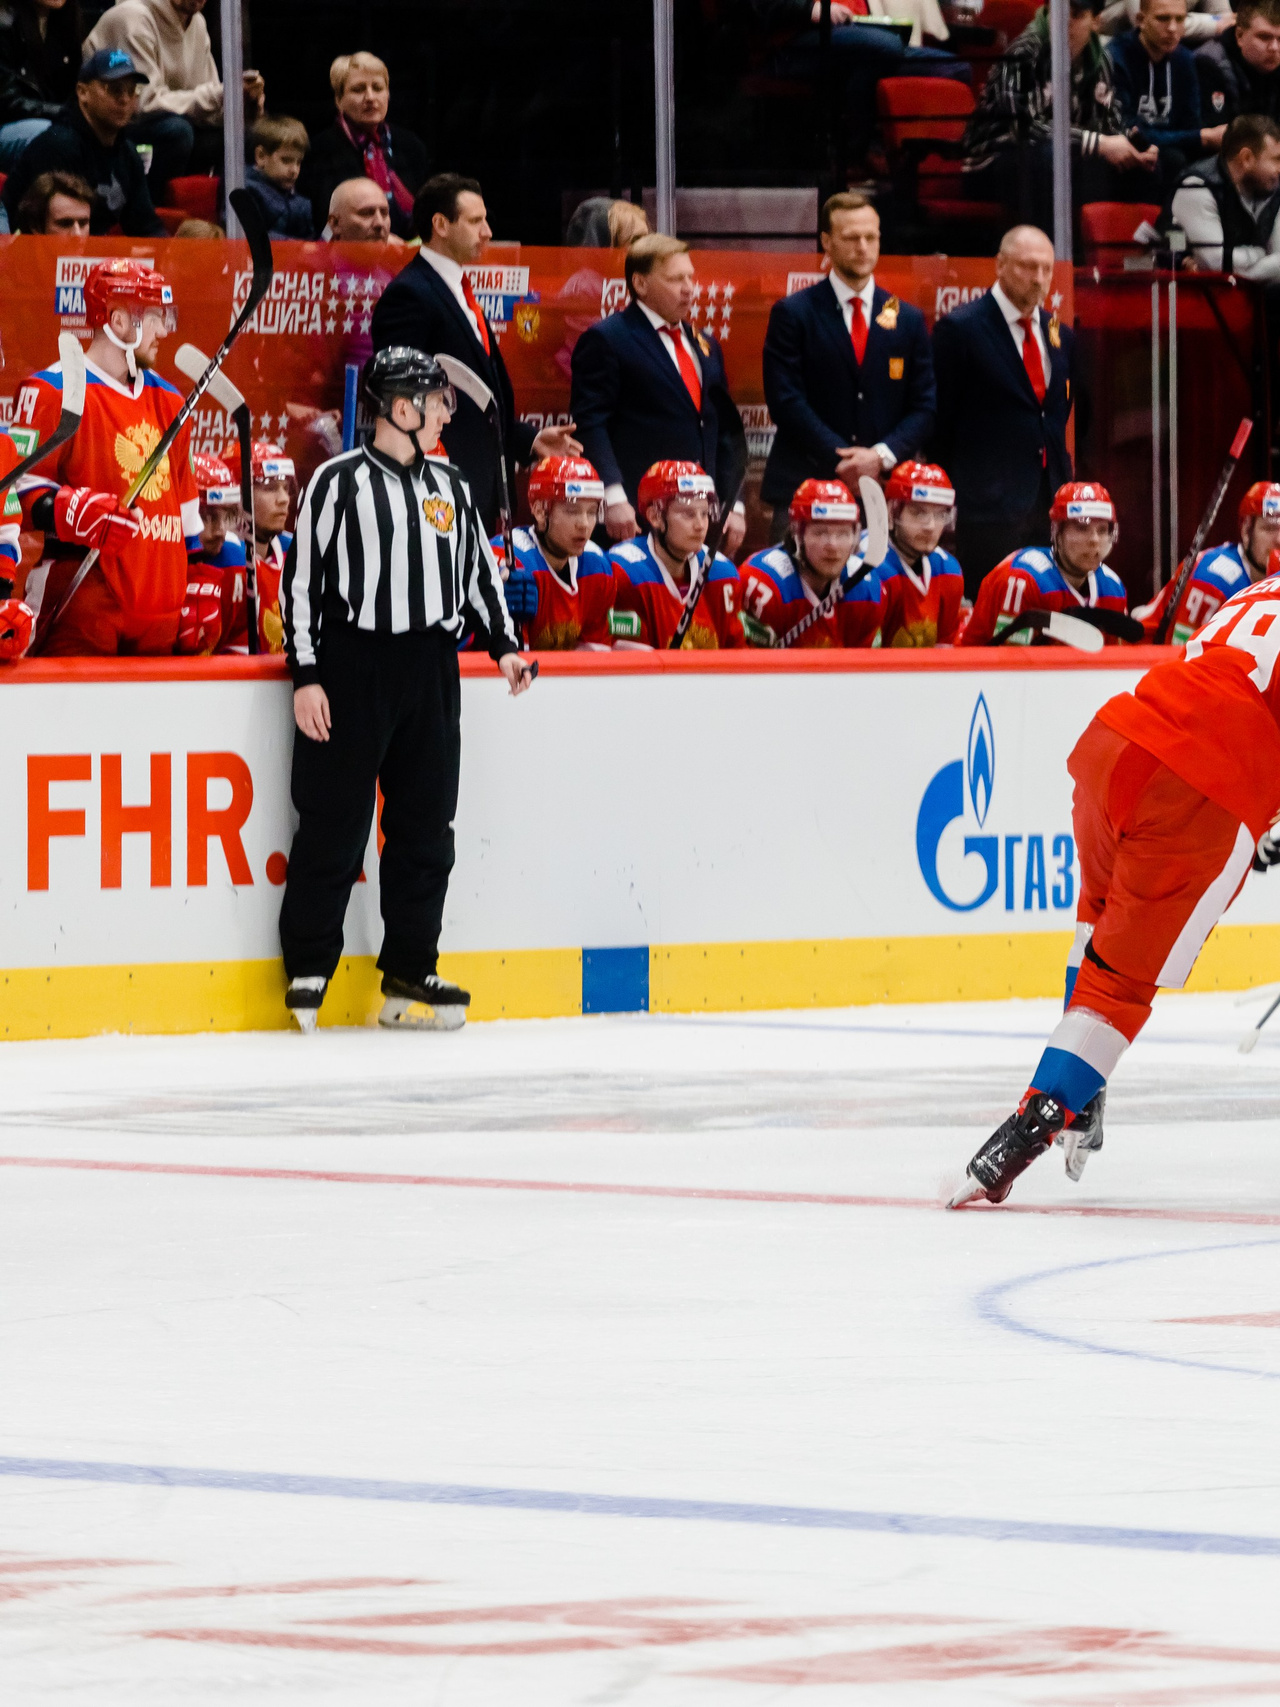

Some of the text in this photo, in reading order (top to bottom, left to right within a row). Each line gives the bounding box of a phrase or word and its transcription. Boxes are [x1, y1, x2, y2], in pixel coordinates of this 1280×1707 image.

[233, 270, 325, 300] КСНАЯ
[232, 573, 244, 603] A
[724, 583, 734, 613] C
[1002, 575, 1027, 613] 11
